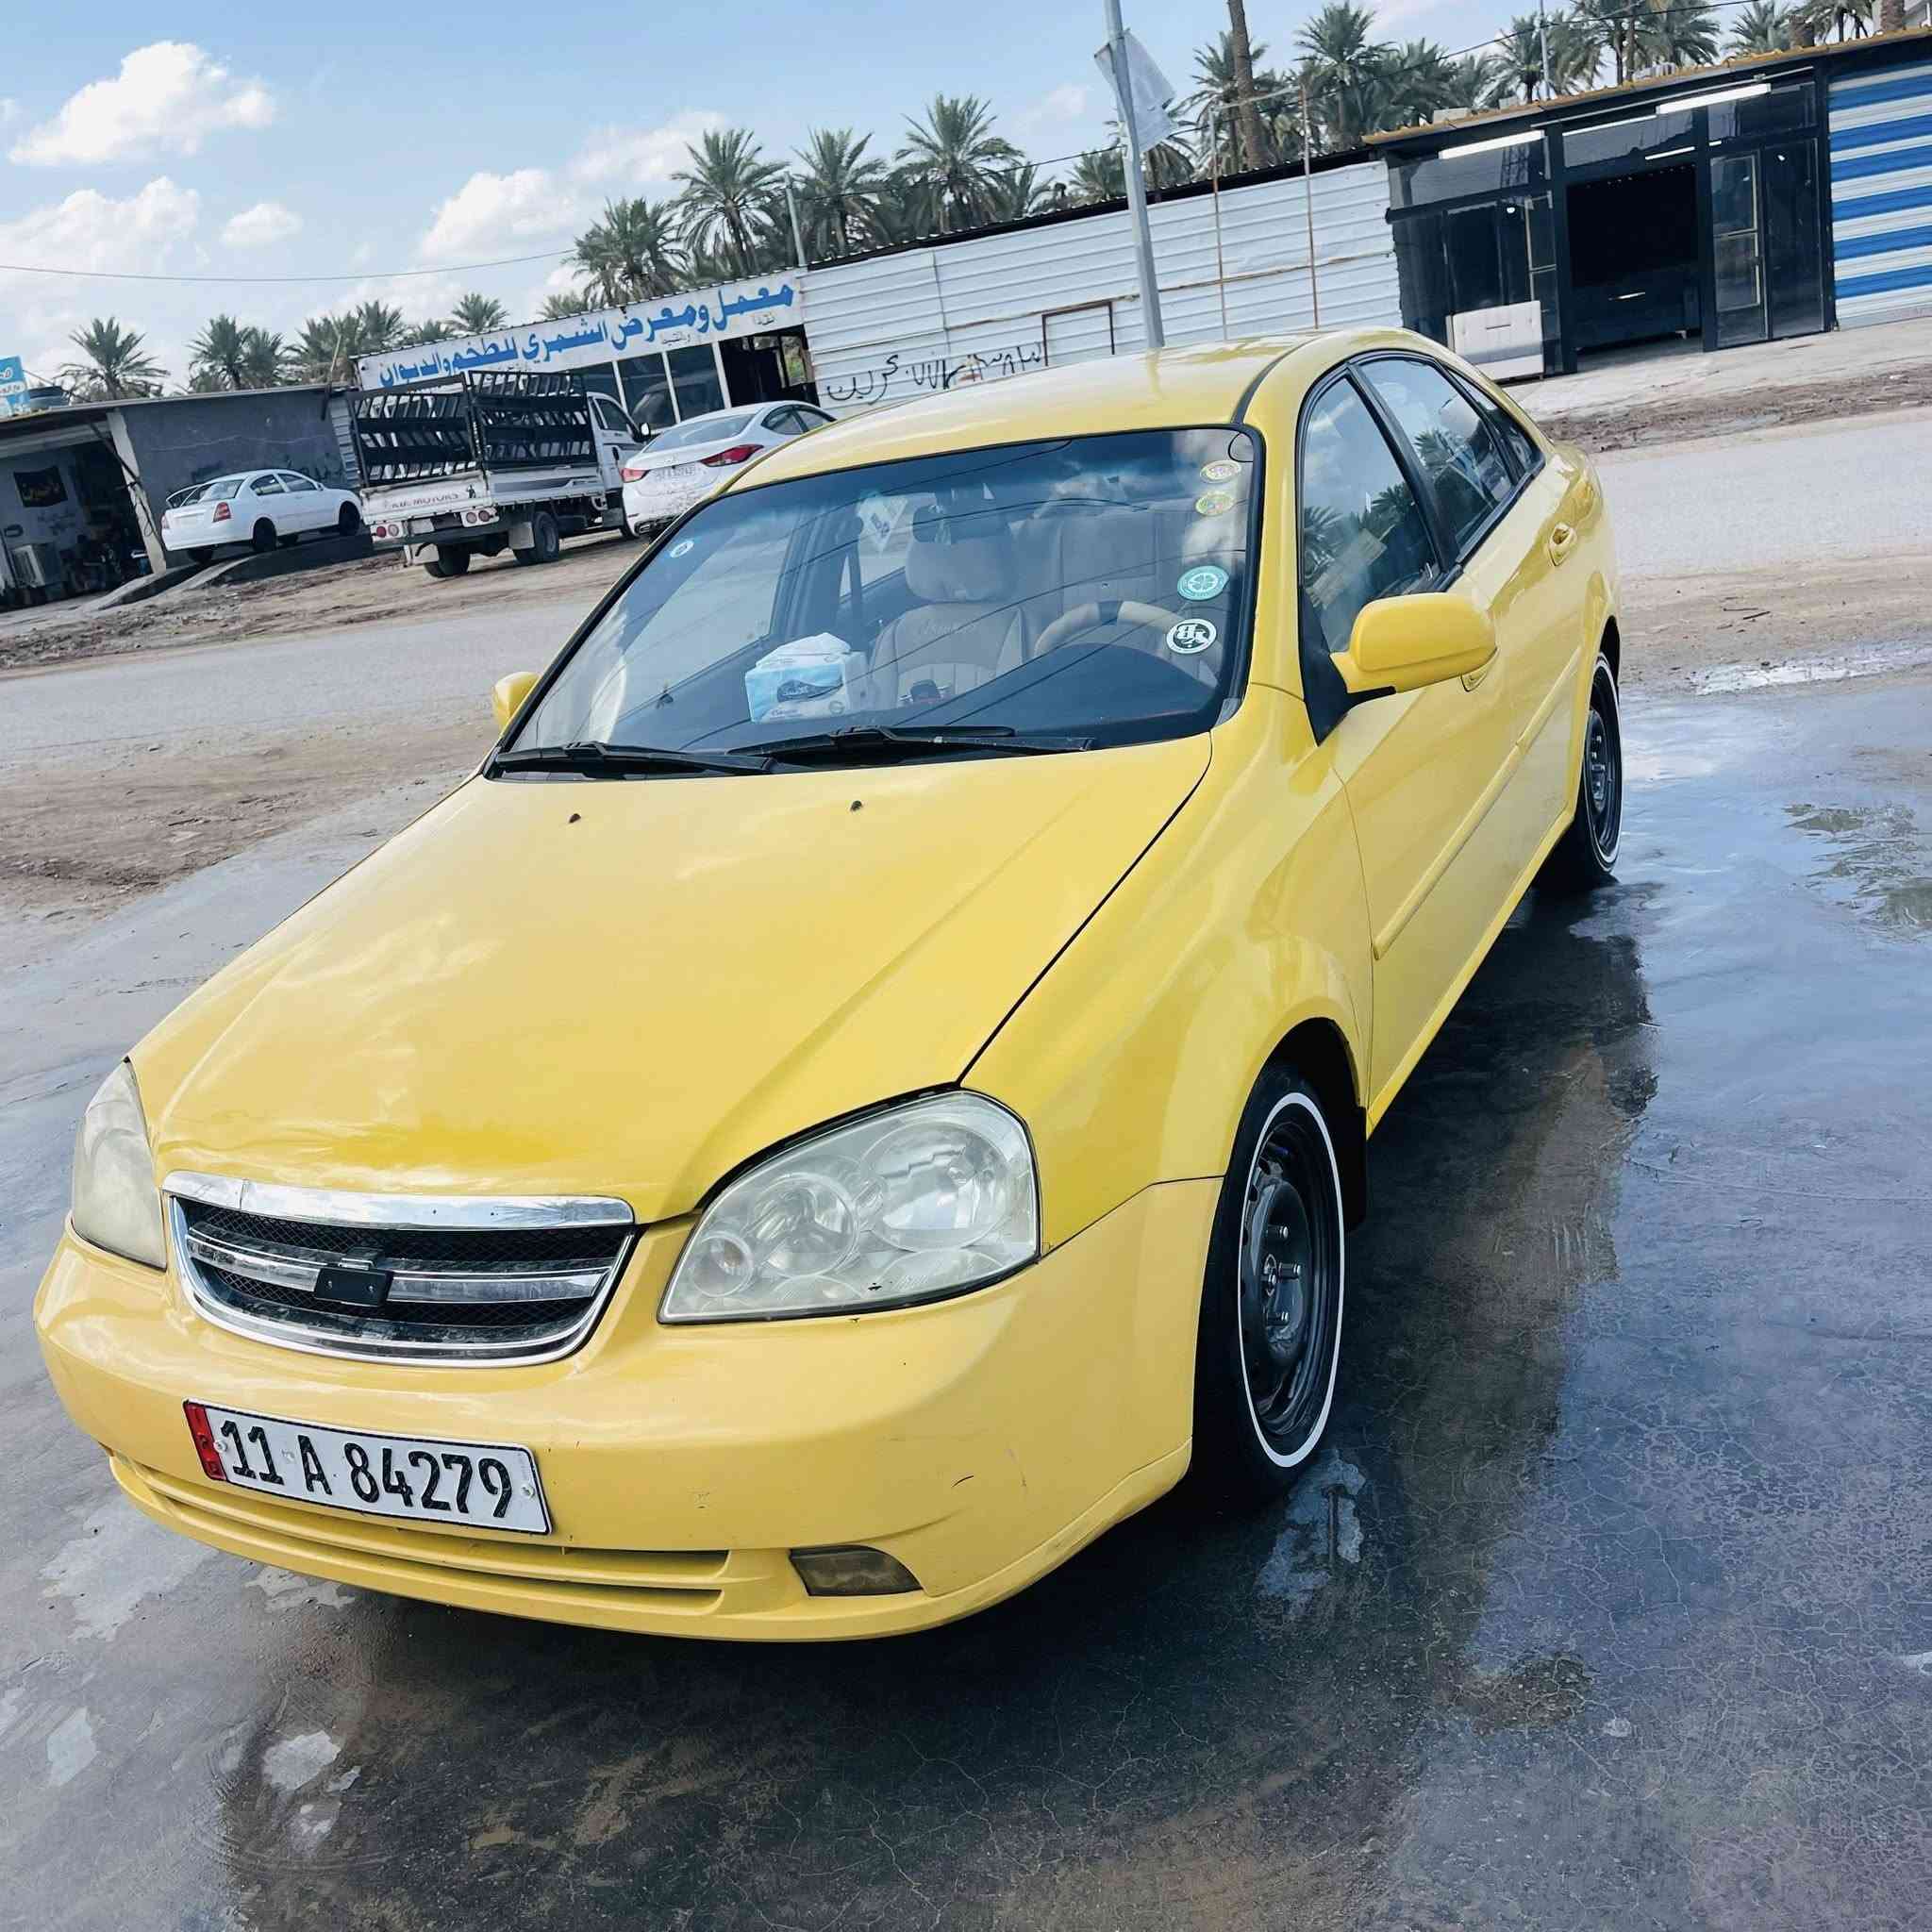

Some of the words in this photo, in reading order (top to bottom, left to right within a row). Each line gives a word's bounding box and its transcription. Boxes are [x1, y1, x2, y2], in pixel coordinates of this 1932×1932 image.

[611, 304, 709, 350] ومعرض
[712, 284, 794, 331] معمل
[522, 317, 608, 363] الشمري
[220, 1419, 286, 1487] 11
[297, 1434, 333, 1497] A
[342, 1441, 514, 1520] 84279
